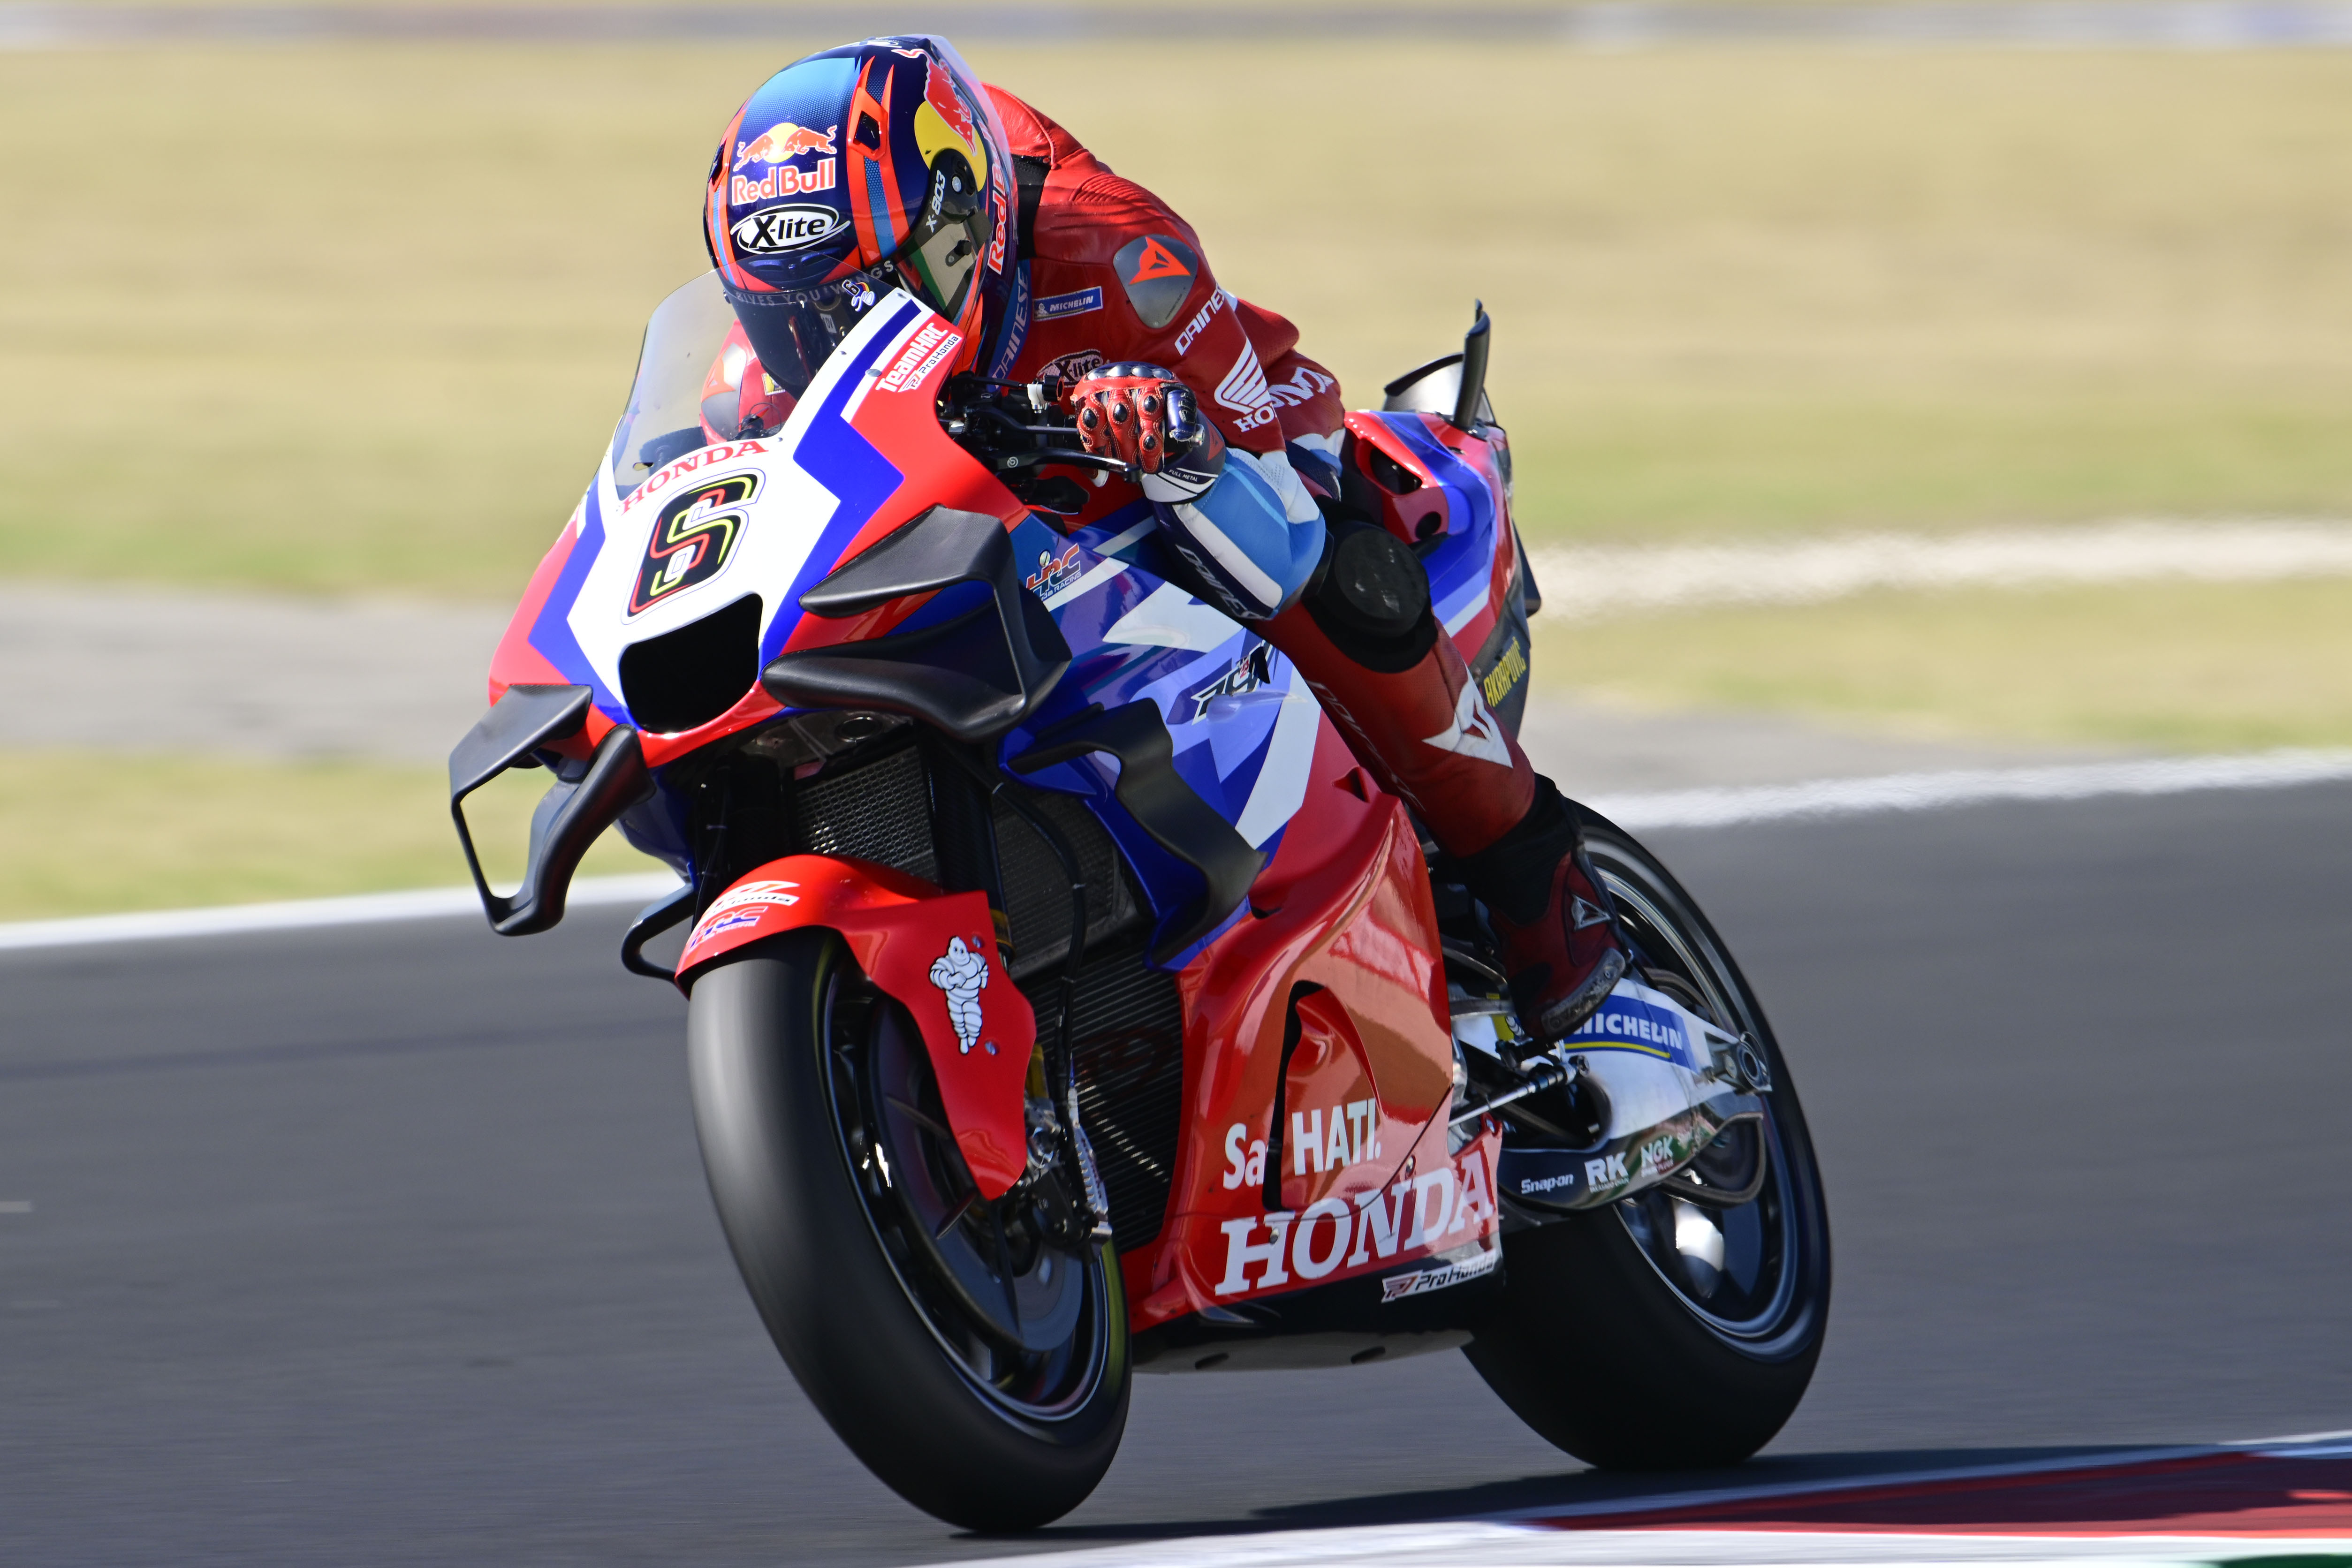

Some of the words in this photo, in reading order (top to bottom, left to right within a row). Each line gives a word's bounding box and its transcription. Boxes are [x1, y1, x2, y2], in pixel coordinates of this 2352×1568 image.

[732, 166, 777, 205] Red
[779, 157, 836, 197] Bull
[926, 169, 945, 233] X-803
[749, 215, 826, 248] X-lite
[987, 189, 1007, 275] Red
[781, 289, 820, 304] YOU
[1050, 295, 1094, 312] MICHELIN
[621, 440, 769, 516] HONDA
[627, 474, 758, 618] 6
[1054, 571, 1082, 593] RACING
[1223, 1123, 1267, 1189] Sa
[1584, 1151, 1629, 1186] RK
[1215, 1150, 1495, 1296] HONDA
